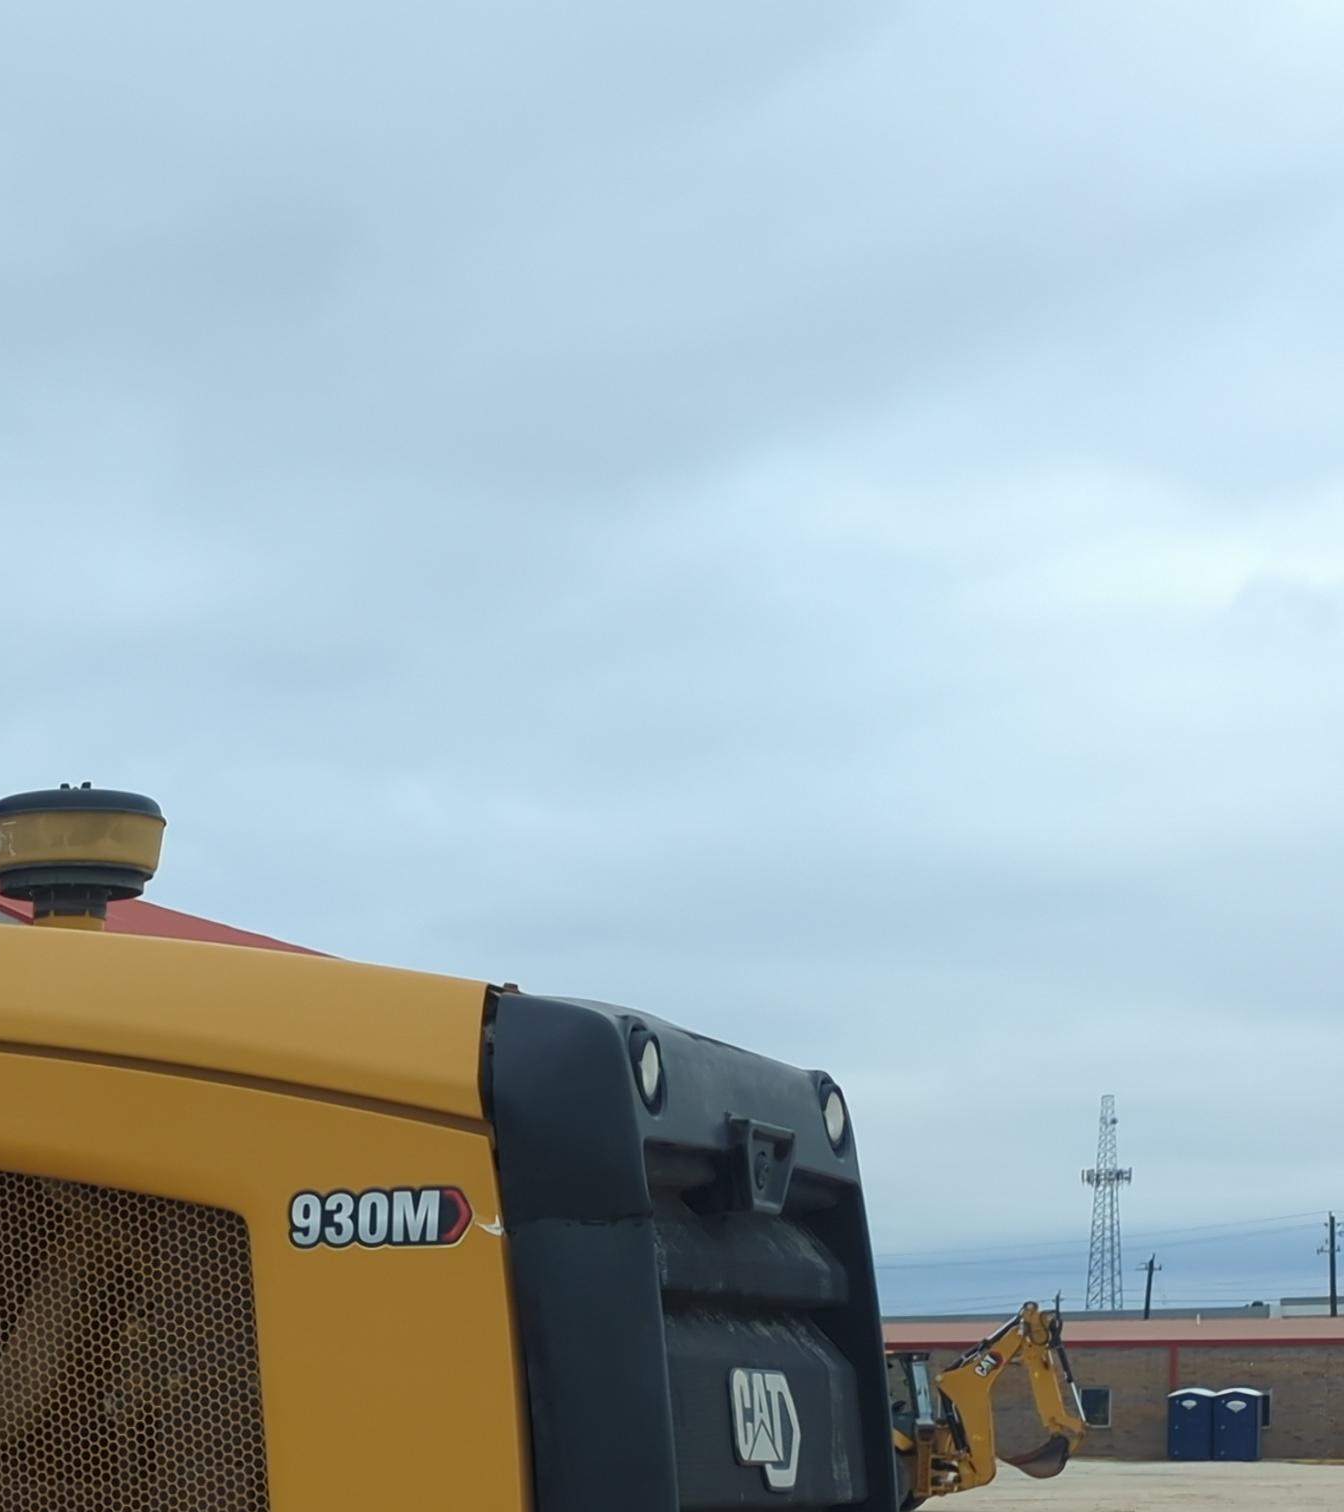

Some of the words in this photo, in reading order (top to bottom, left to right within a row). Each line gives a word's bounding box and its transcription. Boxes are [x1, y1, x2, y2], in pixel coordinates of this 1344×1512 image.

[291, 1189, 440, 1245] 930M
[975, 1354, 998, 1377] CAT
[732, 1368, 786, 1462] CAT
